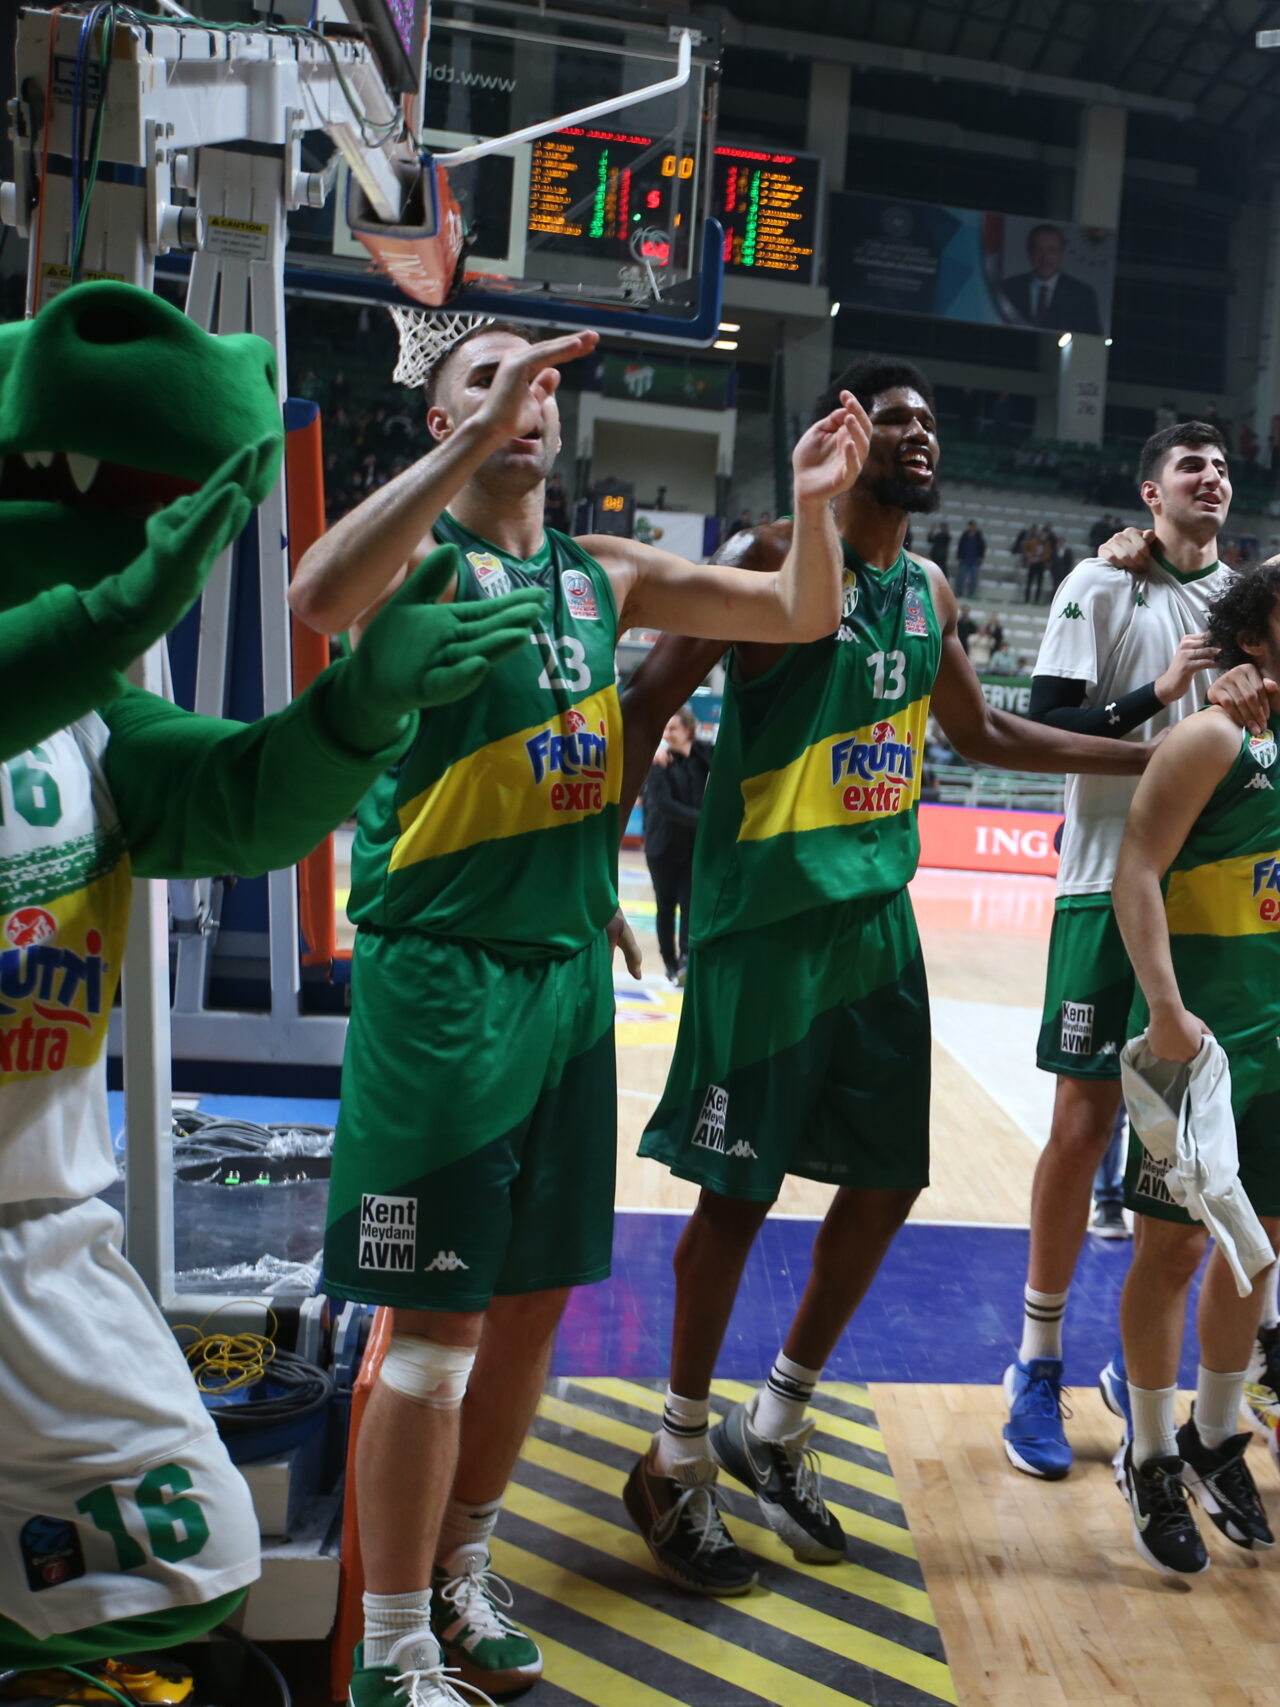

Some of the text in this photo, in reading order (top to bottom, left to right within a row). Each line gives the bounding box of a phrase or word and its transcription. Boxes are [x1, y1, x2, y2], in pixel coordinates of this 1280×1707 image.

[530, 632, 591, 692] 23
[866, 650, 906, 700] 13
[842, 781, 900, 813] extra
[975, 826, 1049, 858] ING
[1063, 1002, 1093, 1023] Kent
[0, 1016, 69, 1072] xtra
[1062, 1034, 1091, 1054] AVM
[362, 1195, 415, 1226] Kent
[361, 1222, 415, 1241] Meydanı
[360, 1241, 414, 1270] AVM
[75, 1463, 210, 1571] 16
